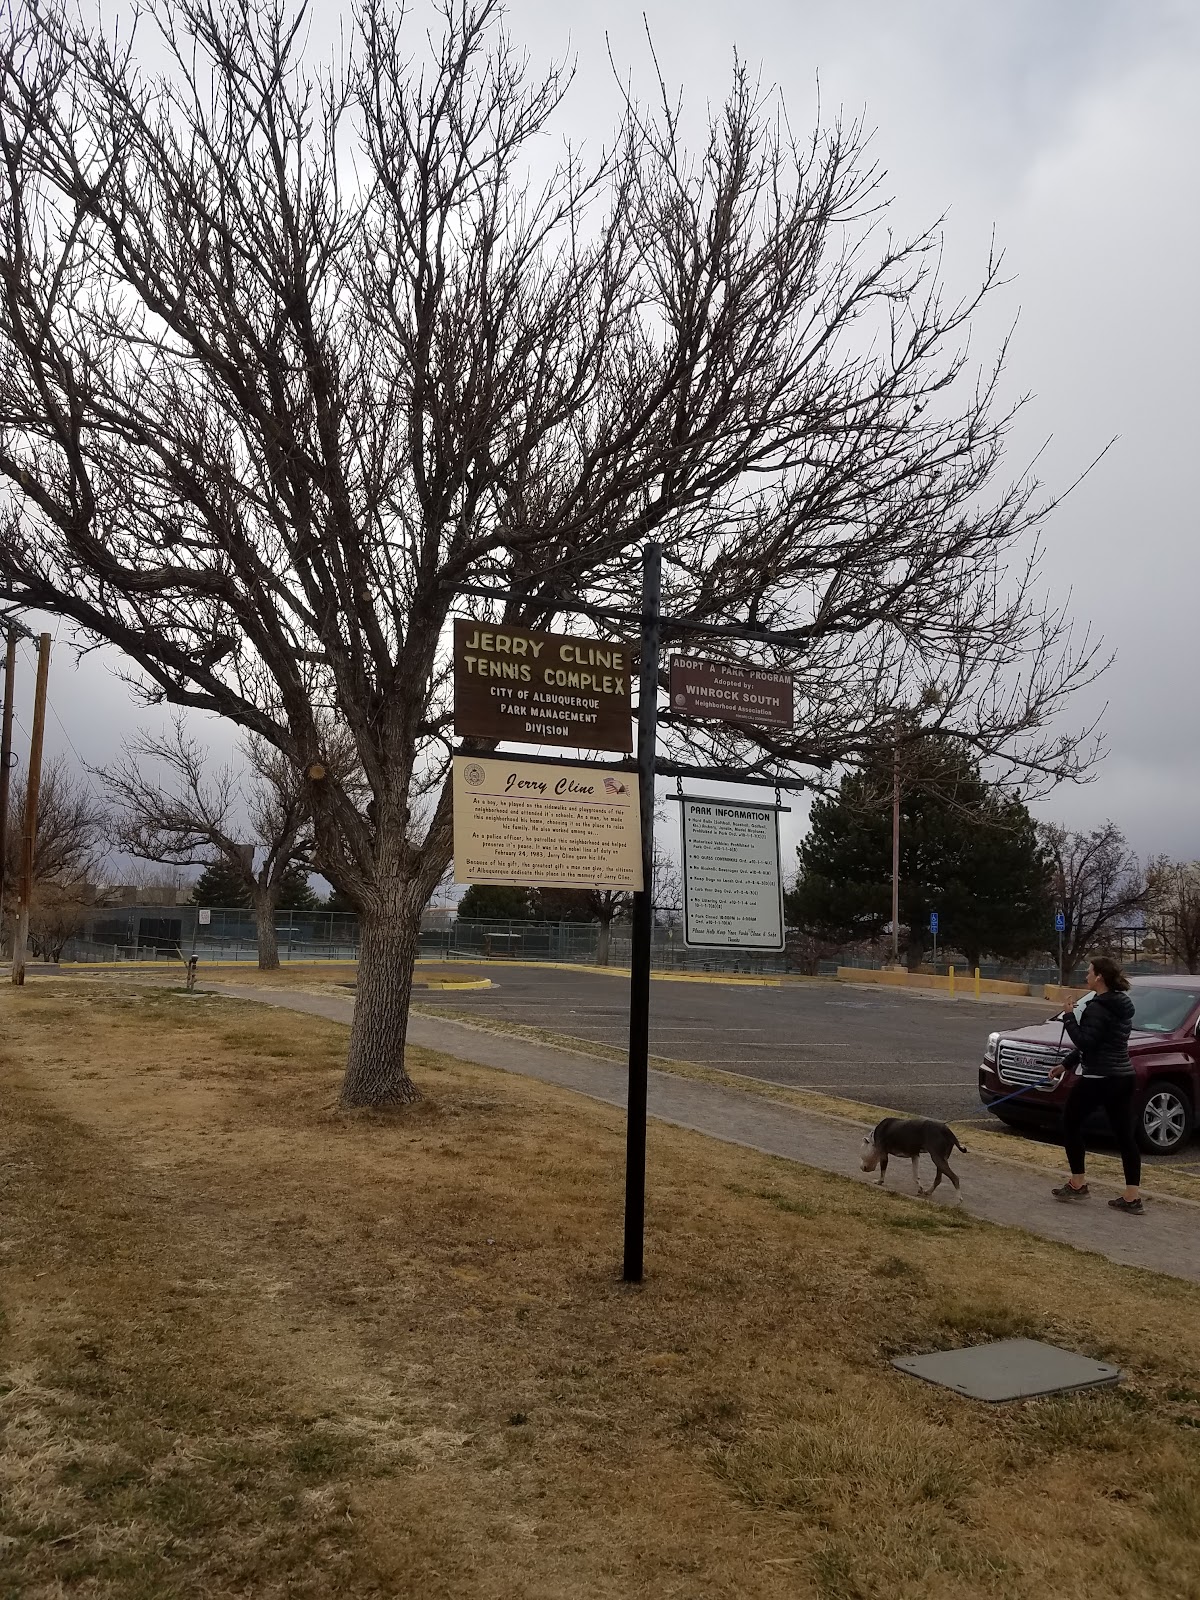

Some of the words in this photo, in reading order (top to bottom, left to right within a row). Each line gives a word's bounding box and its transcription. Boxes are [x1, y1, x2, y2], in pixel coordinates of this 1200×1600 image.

[466, 630, 544, 658] JERRY
[560, 644, 624, 670] CLINE
[464, 655, 531, 681] TENNIS
[544, 668, 625, 695] COMPLEX
[674, 659, 703, 670] ADOPT
[710, 664, 715, 672] A
[722, 666, 744, 677] PARK
[750, 671, 791, 684] PROGRAM
[714, 678, 741, 687] Adopted
[490, 687, 512, 698] CITY
[518, 690, 529, 700] OF
[533, 692, 599, 709] ALBUQUERQUE
[686, 685, 739, 700] WINROCK
[743, 694, 779, 706] SOUTH
[501, 703, 527, 716] PARK
[531, 707, 597, 723] MANAGEMENT
[695, 700, 736, 711] Neighborhood
[738, 706, 771, 715] Association
[525, 722, 568, 736] DIVISION
[505, 774, 547, 794] Jerry
[555, 778, 594, 795] Cline
[691, 806, 711, 815] PARK
[716, 809, 769, 821] INFORMATION
[1014, 1054, 1044, 1068] GMC
